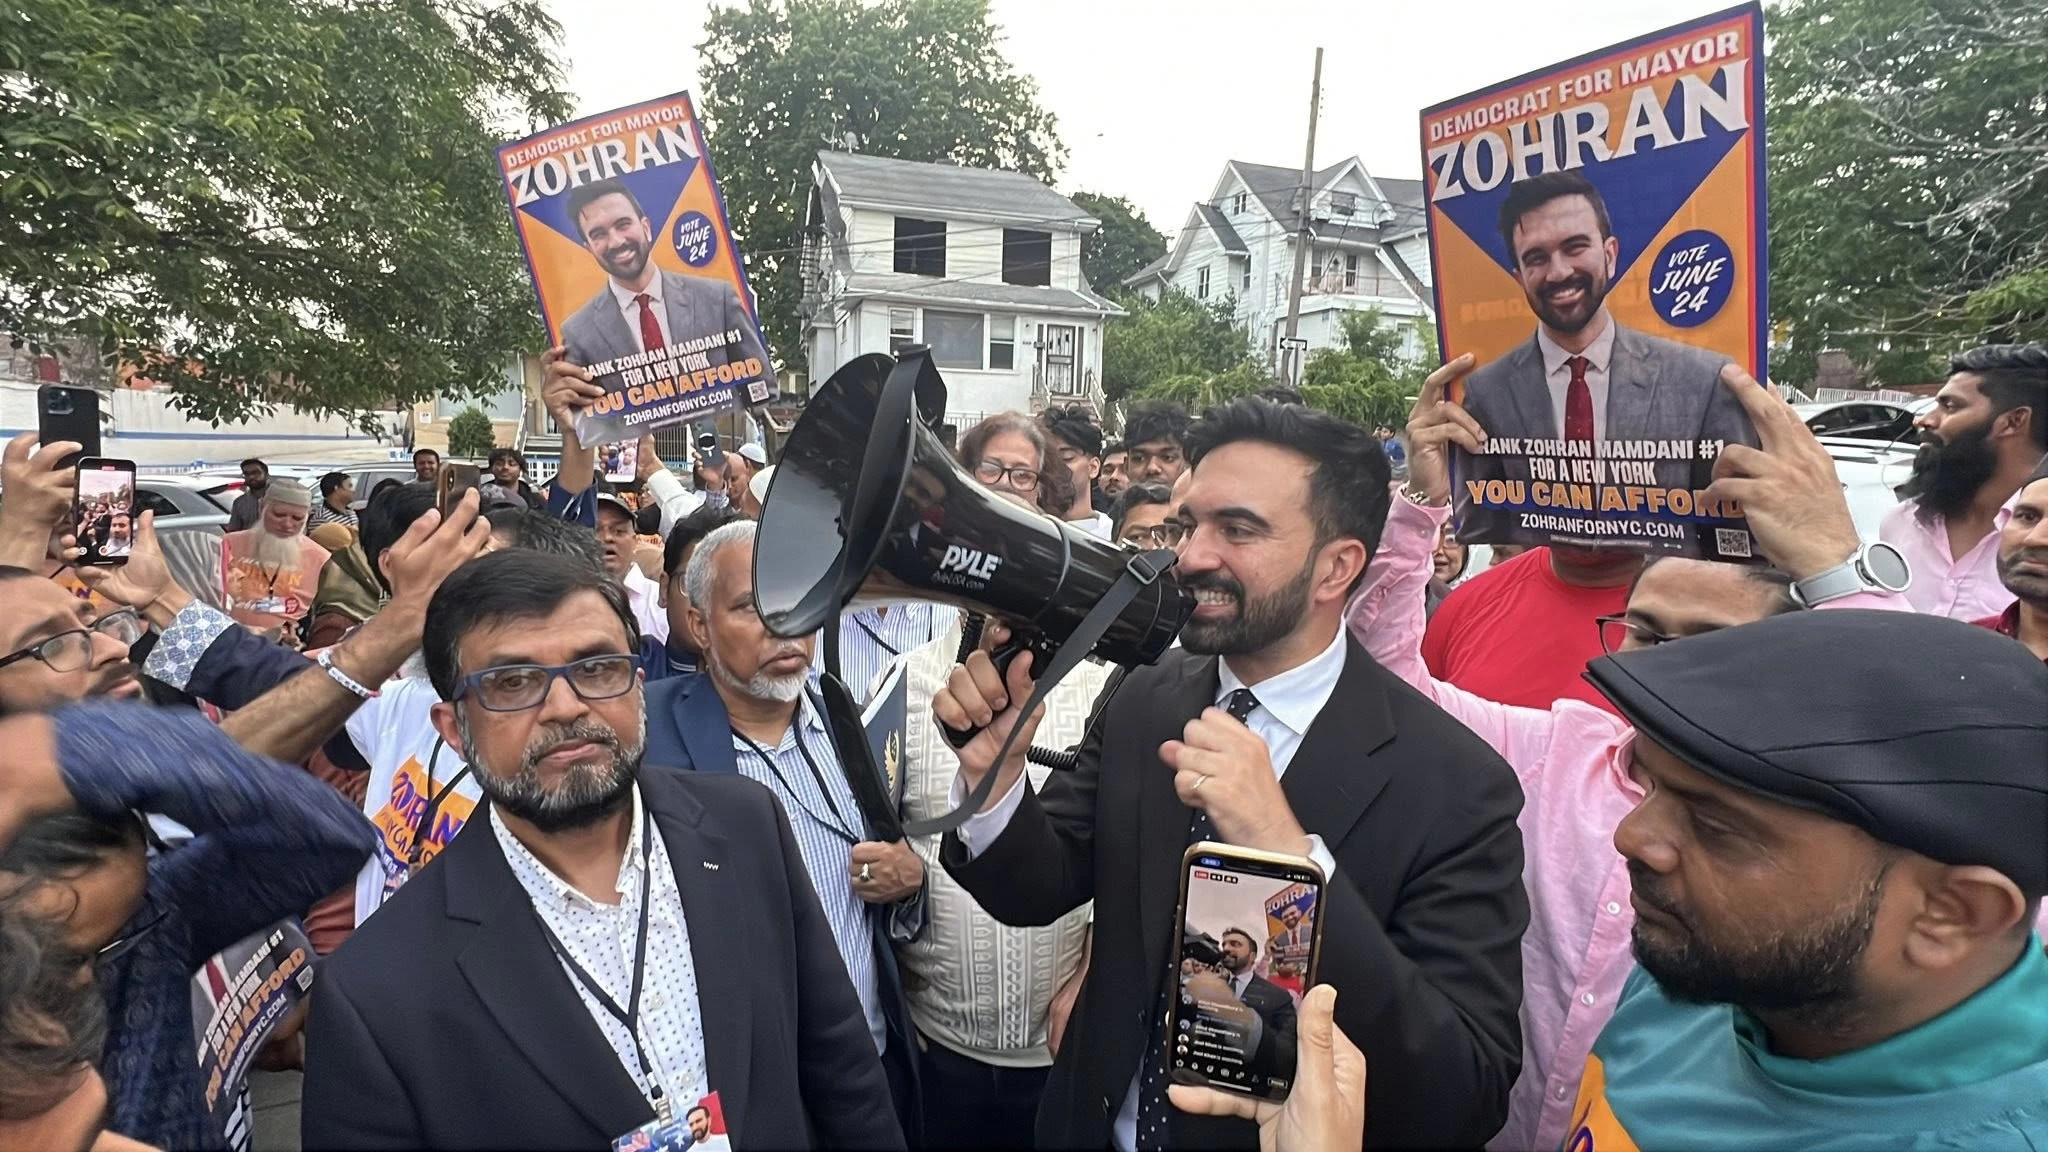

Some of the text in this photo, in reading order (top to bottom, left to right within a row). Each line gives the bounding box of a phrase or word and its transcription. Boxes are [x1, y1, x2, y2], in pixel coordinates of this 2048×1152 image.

[1430, 30, 1740, 143] DEMOCRAT FOR MAYOR
[506, 106, 685, 168] DEMOCRAT FOR MAYOR
[1427, 58, 1750, 202] ZOHRAN
[507, 121, 701, 207] ZOHRAN
[676, 225, 711, 250] JUNE
[680, 218, 700, 234] VOTE
[689, 242, 708, 263] 24
[1668, 244, 1710, 268] VOTE
[1652, 257, 1727, 294] JUNE
[1670, 286, 1710, 317] 24
[615, 350, 666, 372] ZOHRAN
[667, 332, 727, 359] MAMDANI
[726, 328, 742, 344] #1
[621, 351, 711, 388] FOR A NEW YORK
[627, 379, 676, 406] CAN
[679, 357, 763, 393] AFFORD
[623, 388, 733, 427] ZOHRANFORNYC.COM
[1523, 438, 1592, 458] ZOHRAN
[1597, 439, 1694, 460] MAMDANI
[1698, 439, 1724, 460] #1
[1529, 457, 1658, 486] FOR A NEW YORK
[1466, 480, 1526, 505] YOU
[1531, 481, 1593, 511] CAN
[1520, 513, 1685, 540] ZOHRANFORNYC.COM
[939, 544, 999, 580] PYLE
[218, 1020, 244, 1071] CAN
[242, 947, 306, 1031] AFFORD
